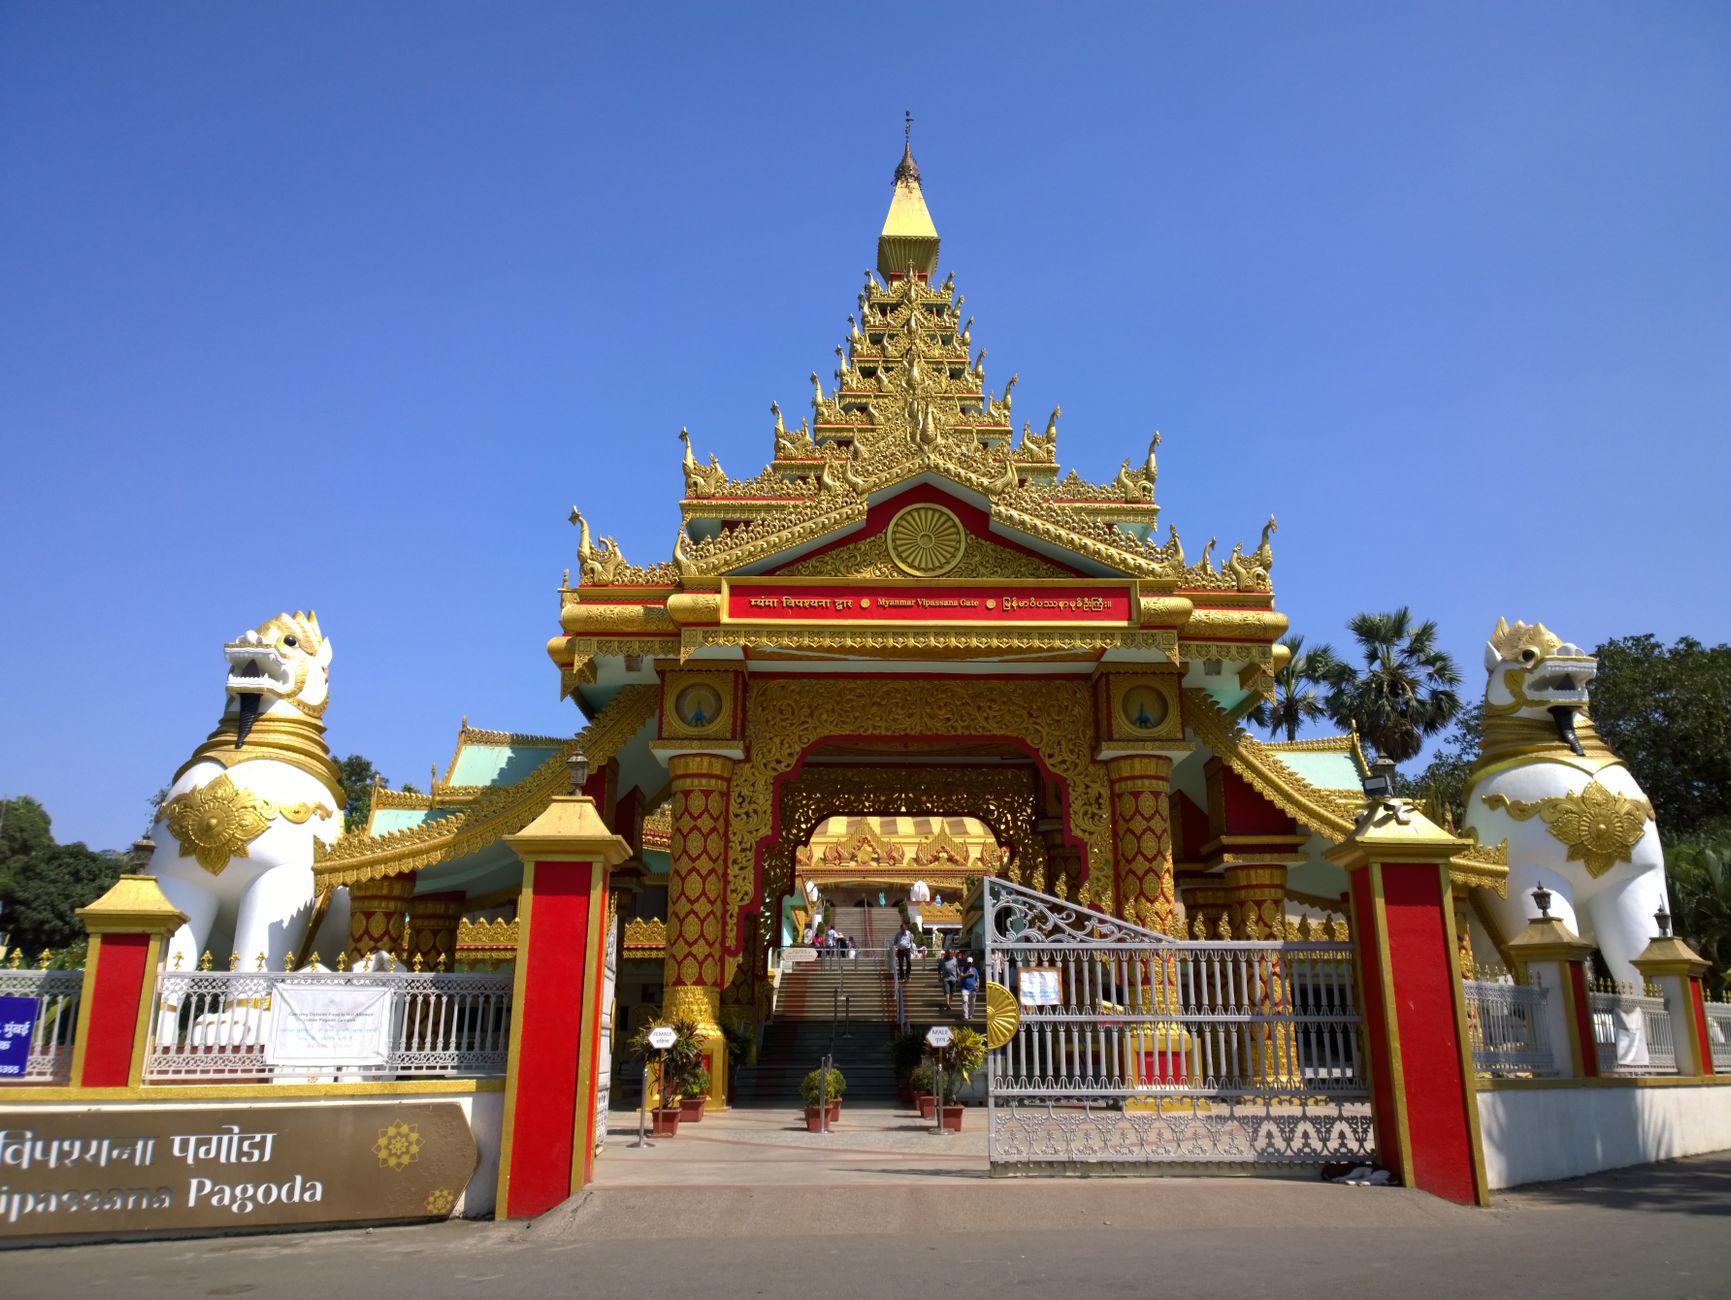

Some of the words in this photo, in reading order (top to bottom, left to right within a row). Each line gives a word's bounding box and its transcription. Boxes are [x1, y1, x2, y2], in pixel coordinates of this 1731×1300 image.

[780, 596, 831, 607] विपश्यना
[834, 599, 853, 610] द्वार
[877, 598, 915, 608] Myanmar
[917, 598, 958, 607] Vipassana
[960, 599, 979, 607] Gate
[170, 1124, 278, 1165] पगोडा
[0, 1184, 173, 1223] ipassana
[188, 1174, 323, 1214] Pagoda
